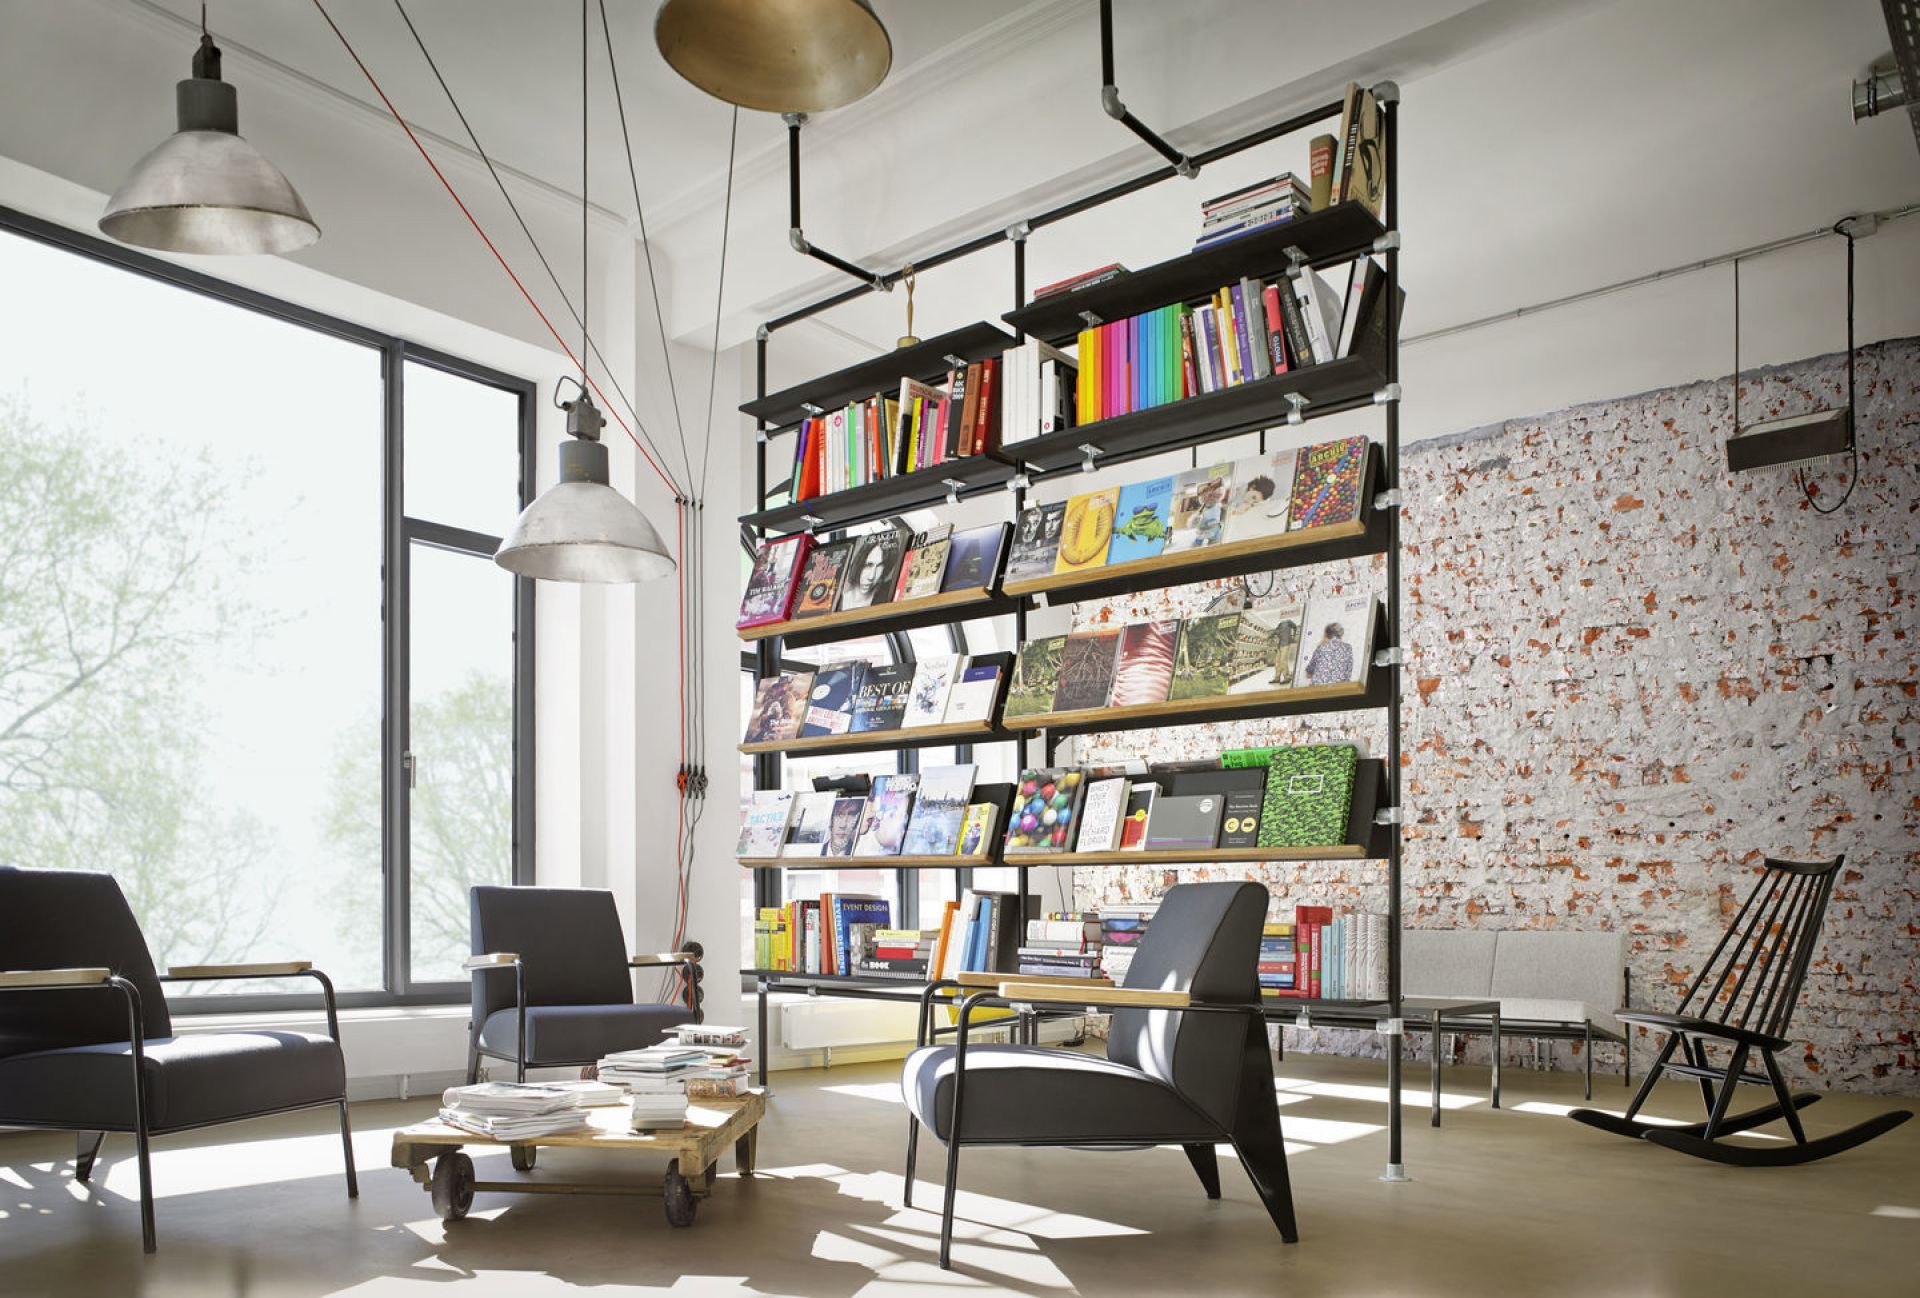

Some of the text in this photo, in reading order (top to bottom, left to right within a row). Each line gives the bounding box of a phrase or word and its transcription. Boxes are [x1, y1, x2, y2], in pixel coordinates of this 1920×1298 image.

[1274, 335, 1282, 363] PHOTO
[859, 681, 912, 698] BEST OF
[843, 903, 889, 912] EVENT DESIGN
